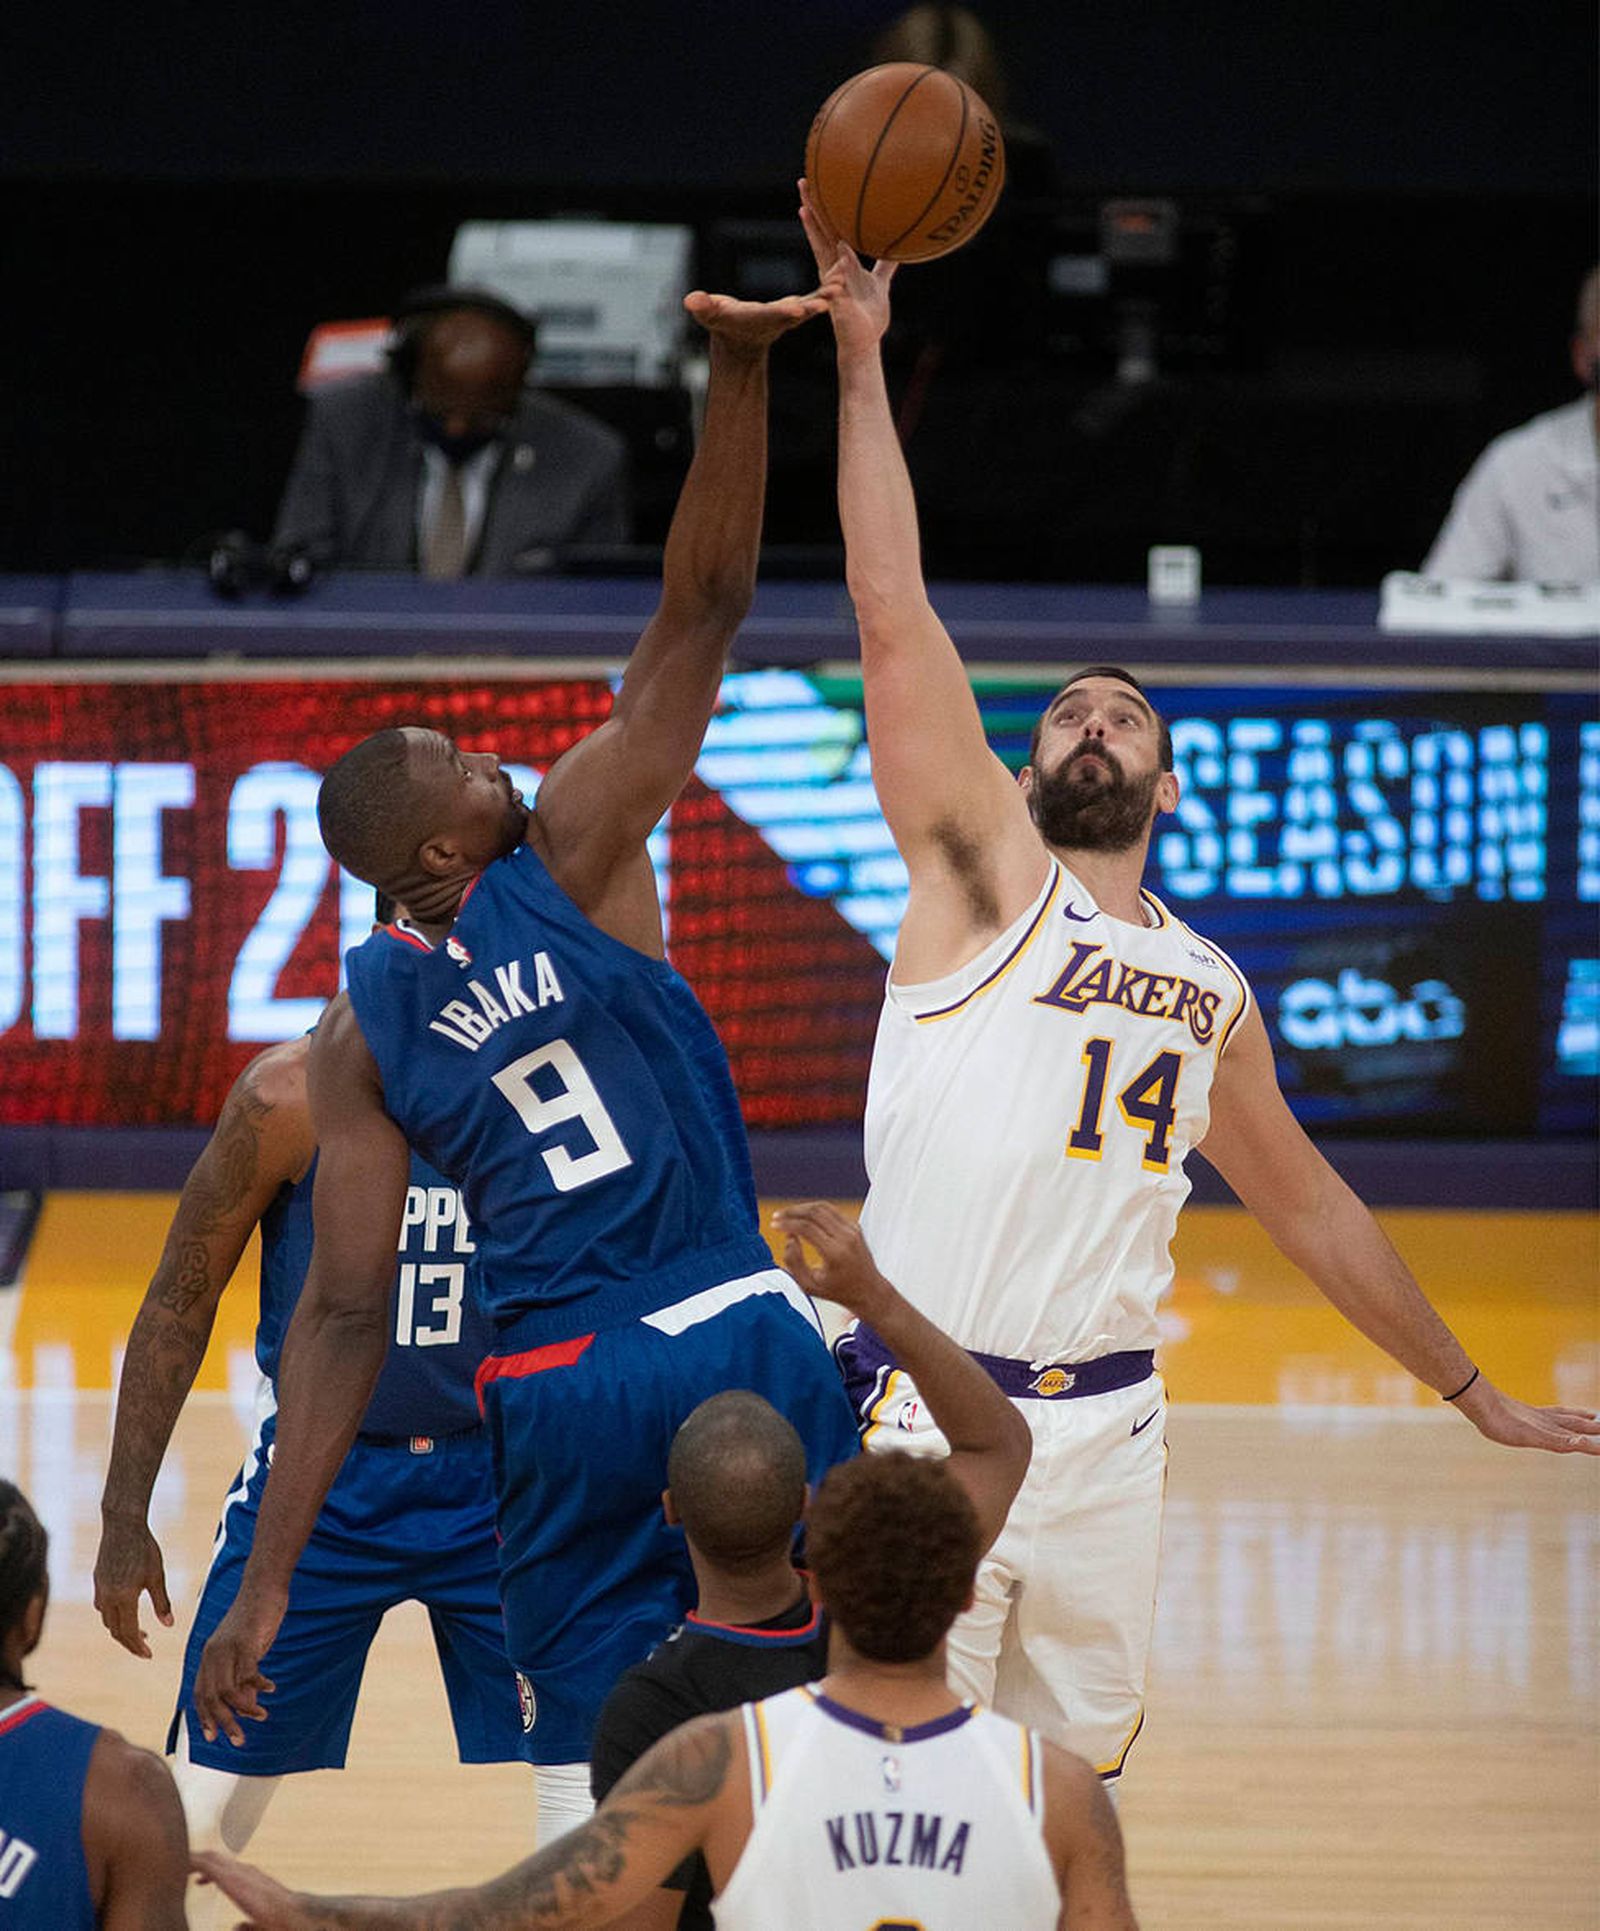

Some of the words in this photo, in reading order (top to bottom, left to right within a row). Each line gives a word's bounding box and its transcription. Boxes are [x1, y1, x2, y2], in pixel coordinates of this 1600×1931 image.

[1159, 718, 1549, 900] SEASON
[0, 759, 197, 1042] FF
[429, 950, 566, 1052] IBAKA
[1031, 940, 1223, 1047] LAKERS
[491, 1038, 634, 1193] 9
[1065, 1035, 1185, 1175] 14
[396, 1263, 465, 1347] 13
[0, 1828, 38, 1899] D
[826, 1811, 971, 1876] KUZMA
